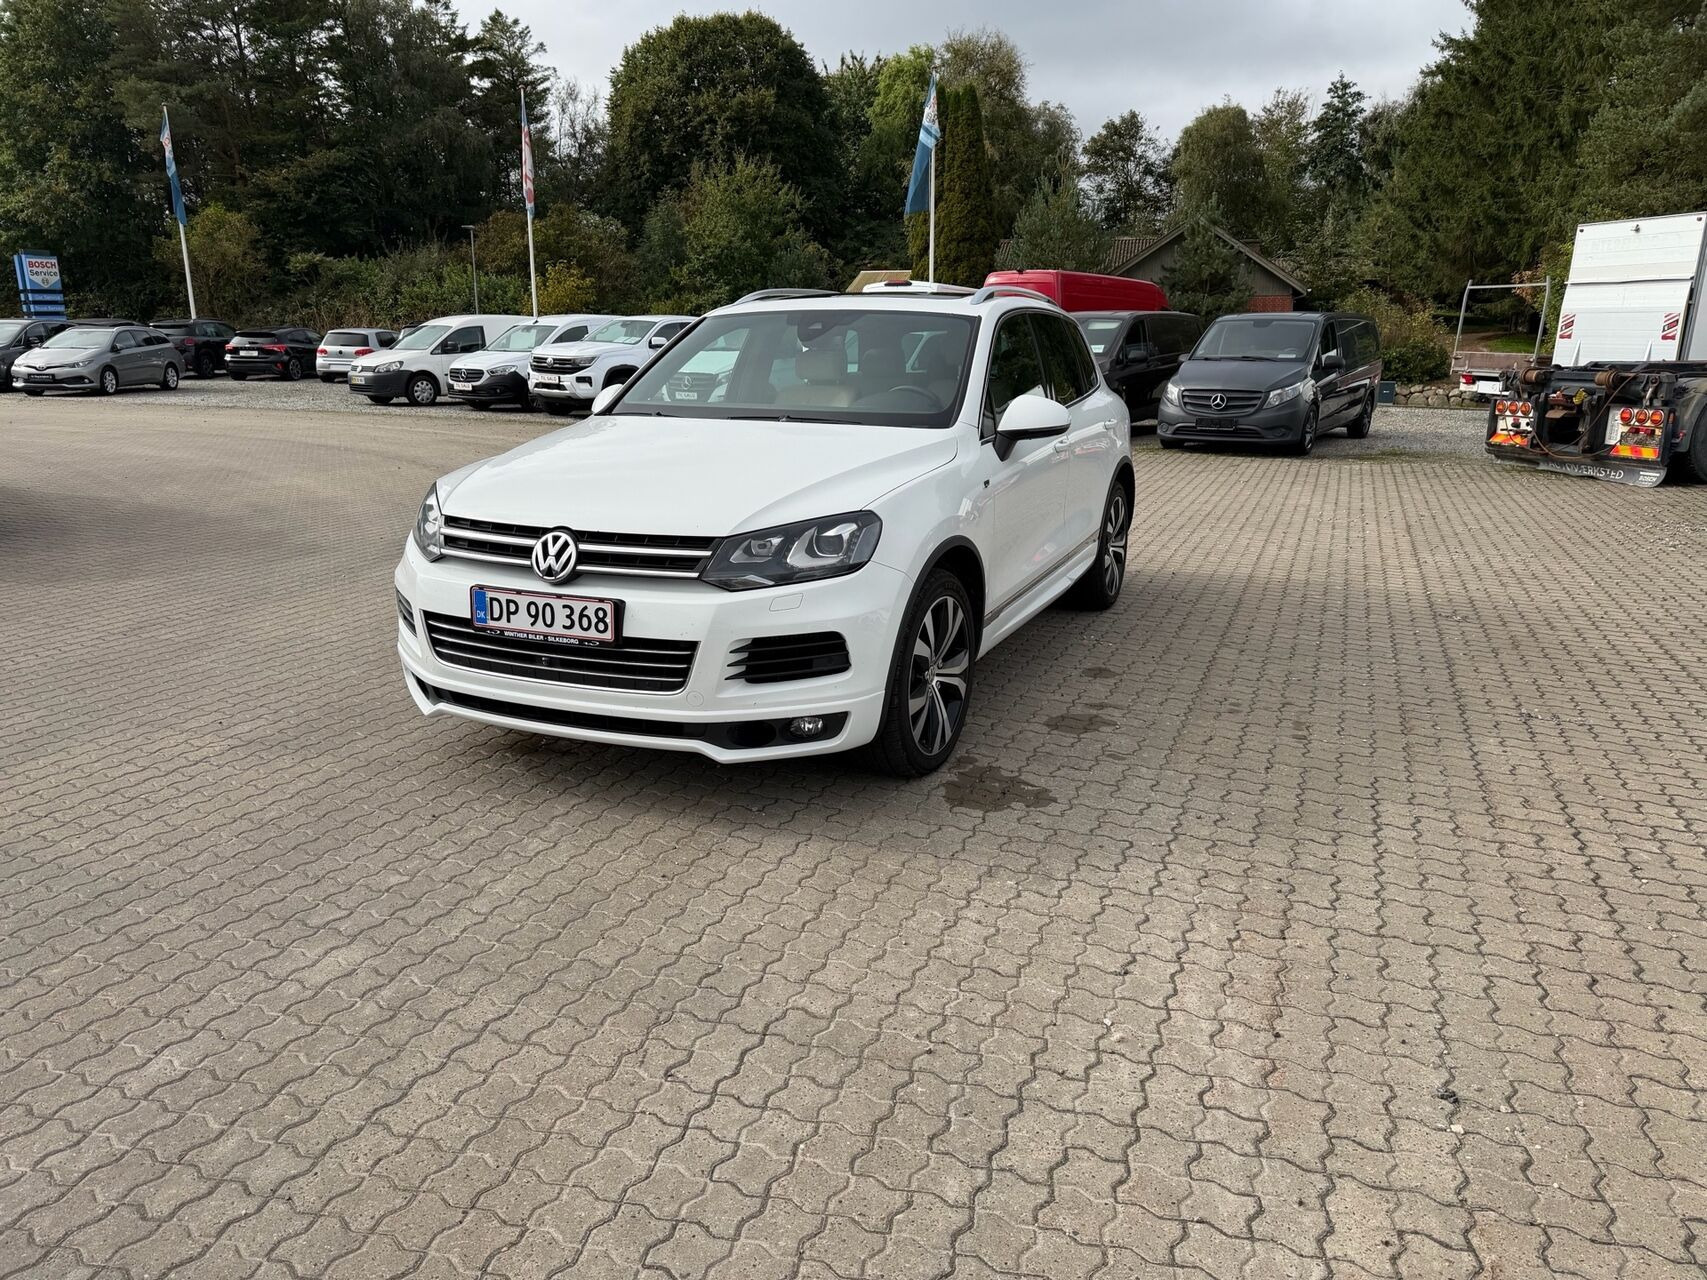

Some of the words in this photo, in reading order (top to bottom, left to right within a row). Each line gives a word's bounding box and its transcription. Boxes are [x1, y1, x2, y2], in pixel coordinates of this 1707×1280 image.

[532, 532, 576, 580] VW
[476, 610, 486, 618] DK
[489, 597, 519, 623] DP
[526, 600, 555, 628] 90
[562, 604, 609, 634] 368
[548, 636, 578, 644] SILKEBORG
